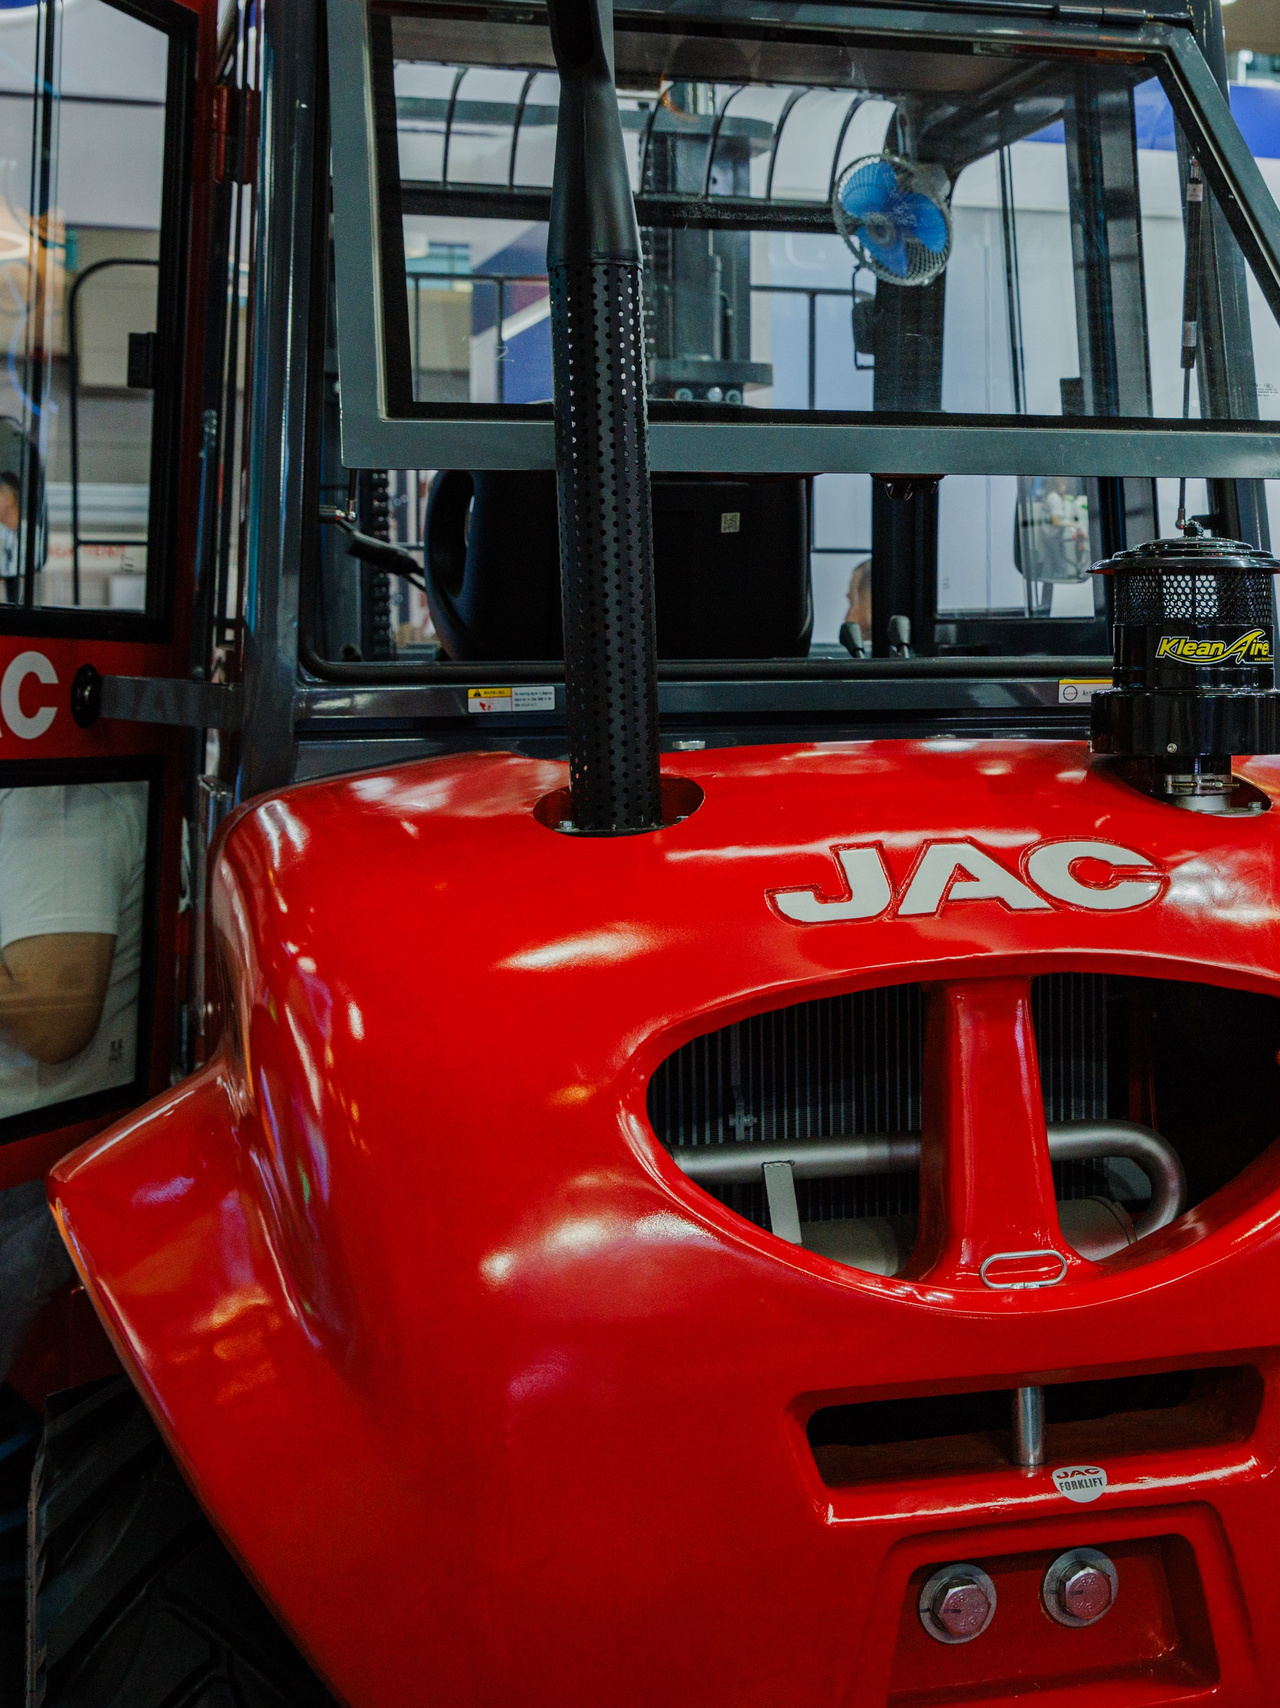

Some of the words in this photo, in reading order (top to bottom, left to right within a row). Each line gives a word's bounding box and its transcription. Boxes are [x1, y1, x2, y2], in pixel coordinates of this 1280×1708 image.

[0, 650, 60, 740] C
[767, 837, 1170, 927] JAC
[1056, 1468, 1100, 1479] JAC
[1059, 1477, 1103, 1491] FORKLIFT
